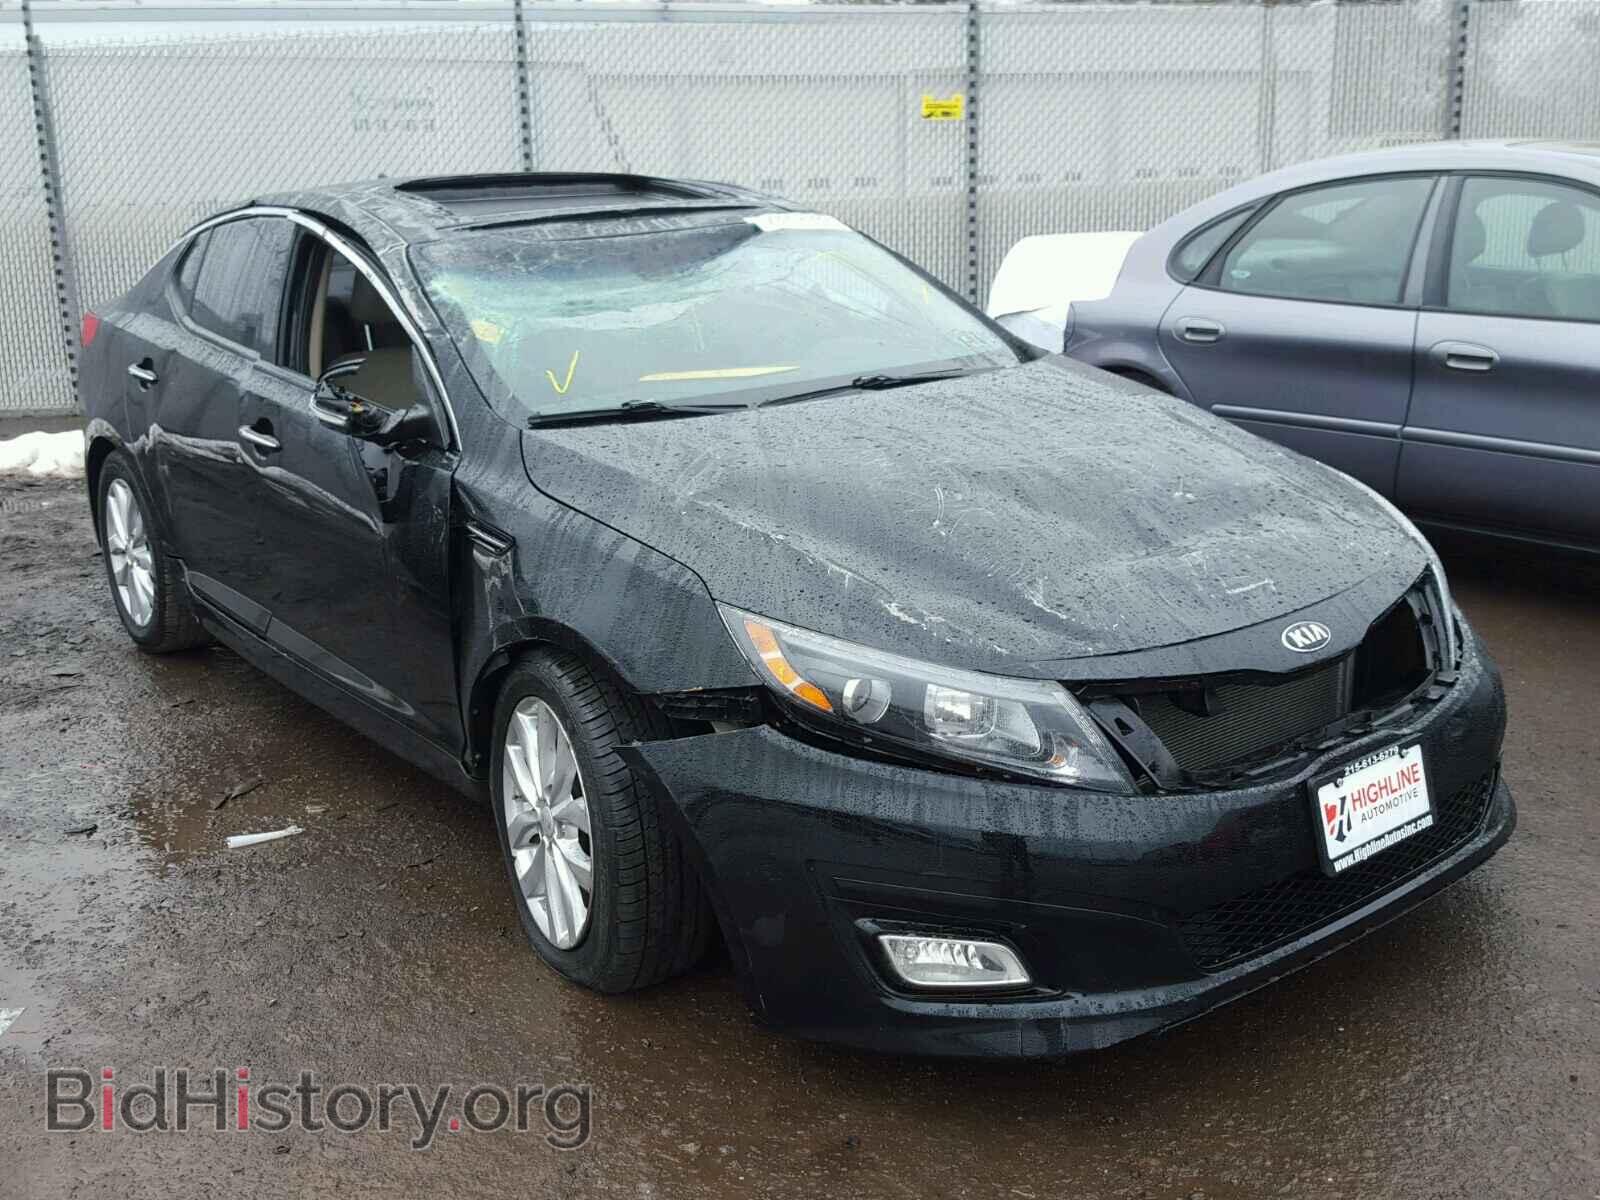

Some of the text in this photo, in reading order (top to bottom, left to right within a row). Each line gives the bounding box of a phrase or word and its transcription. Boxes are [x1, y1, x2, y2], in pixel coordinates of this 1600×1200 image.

[1287, 624, 1329, 648] KIA
[1350, 762, 1421, 812] HIGHLINE
[1360, 786, 1420, 824] AUTOMOTIVE
